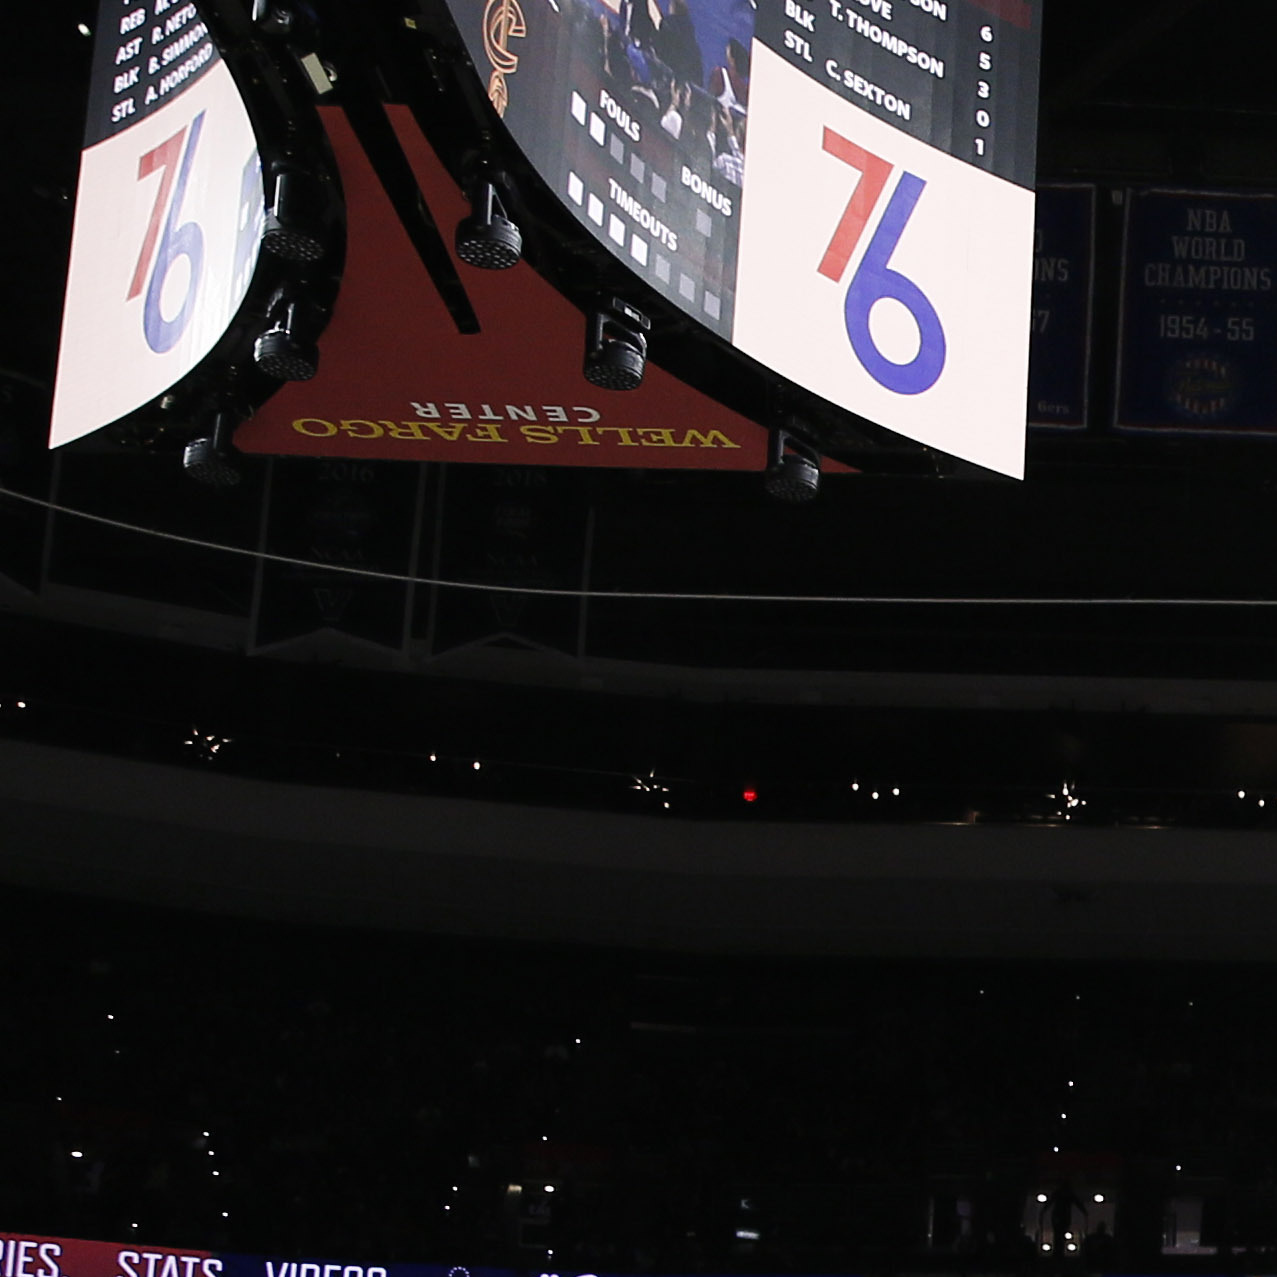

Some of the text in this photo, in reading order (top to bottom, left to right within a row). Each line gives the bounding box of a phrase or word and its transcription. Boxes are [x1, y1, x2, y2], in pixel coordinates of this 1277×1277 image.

[115, 37, 143, 64] AST
[166, 3, 197, 36] NETO
[120, 8, 146, 34] REB
[980, 26, 993, 42] 6
[784, 0, 815, 33] BLK
[846, 8, 944, 78] THOMPSON
[979, 52, 992, 70] 5
[111, 98, 136, 122] STL
[160, 42, 213, 95] HORFORD
[113, 66, 140, 93] BLK
[784, 30, 985, 155] STL C. SEXTON 1
[977, 81, 990, 98] 3
[600, 89, 641, 142] FOULS
[681, 165, 733, 217] BONUS
[608, 177, 679, 252] TIMEOUTS
[1186, 207, 1233, 233] NBA
[126, 110, 207, 354] 76
[817, 125, 947, 396] 76
[1171, 236, 1246, 262] WORLD
[1144, 264, 1272, 291] CHAMPIONS
[410, 400, 602, 423] CENTER
[292, 417, 741, 449] WELLS FARGO
